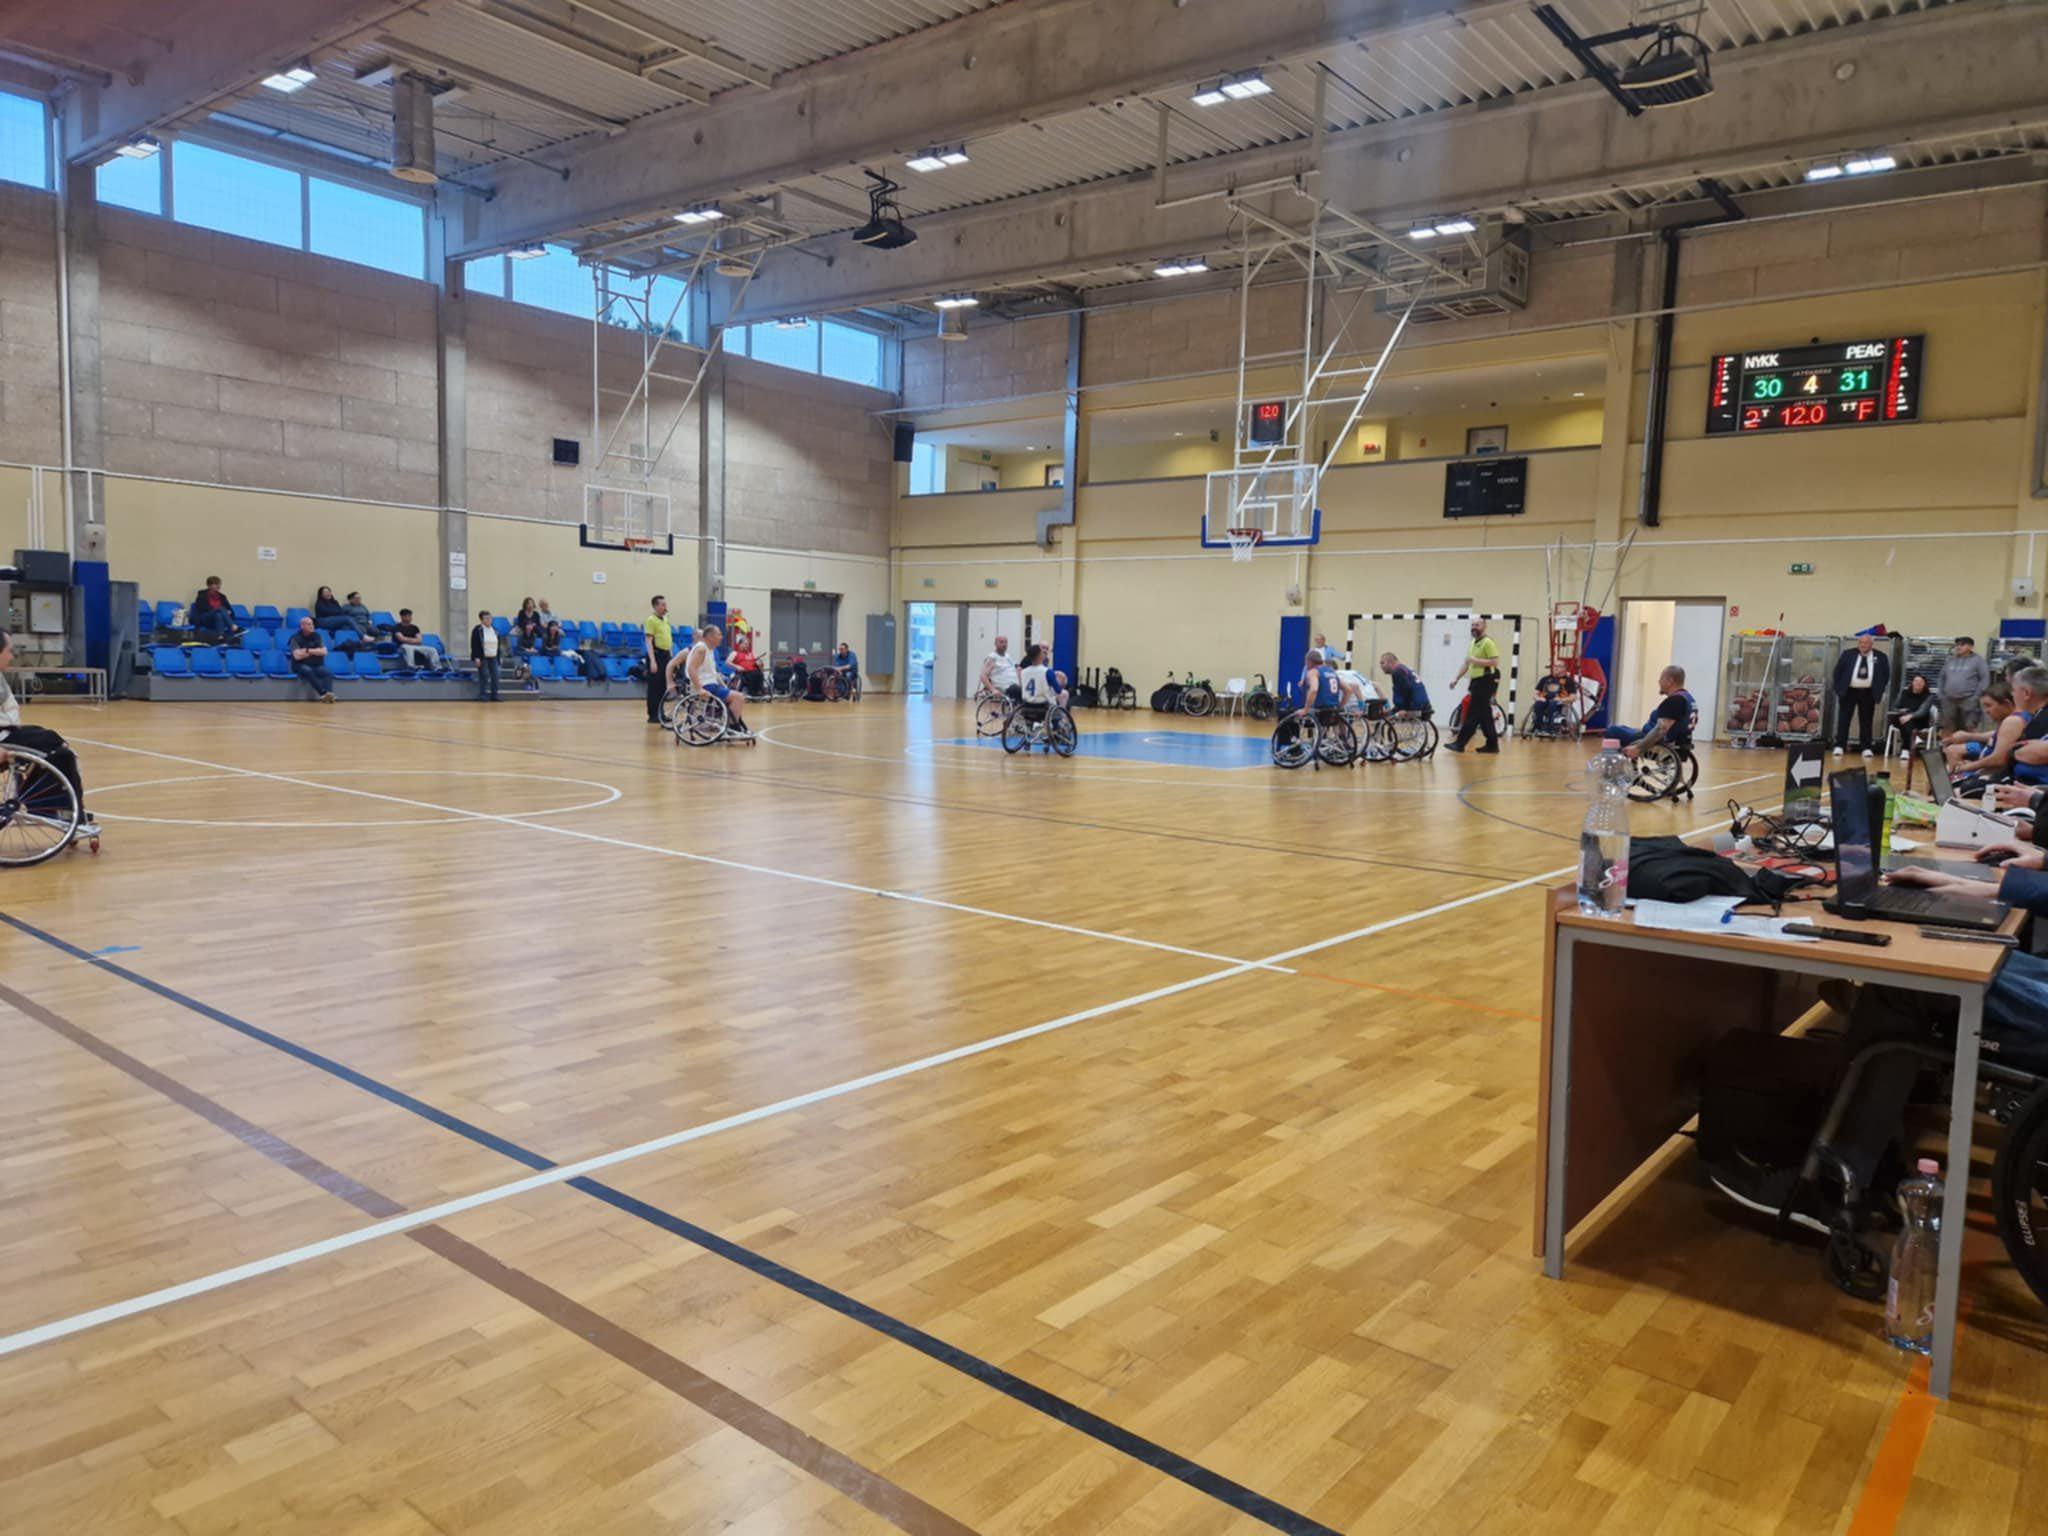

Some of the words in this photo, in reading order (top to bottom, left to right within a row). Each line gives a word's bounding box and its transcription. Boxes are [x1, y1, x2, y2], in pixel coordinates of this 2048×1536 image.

[1745, 353, 1779, 369] NYKK
[1845, 343, 1886, 360] PEAC
[1754, 378, 1782, 398] 30
[1802, 374, 1819, 394] 4
[1839, 370, 1869, 392] 31
[1781, 405, 1825, 426] 12.0
[1858, 400, 1875, 421] F
[1025, 678, 1036, 697] 4
